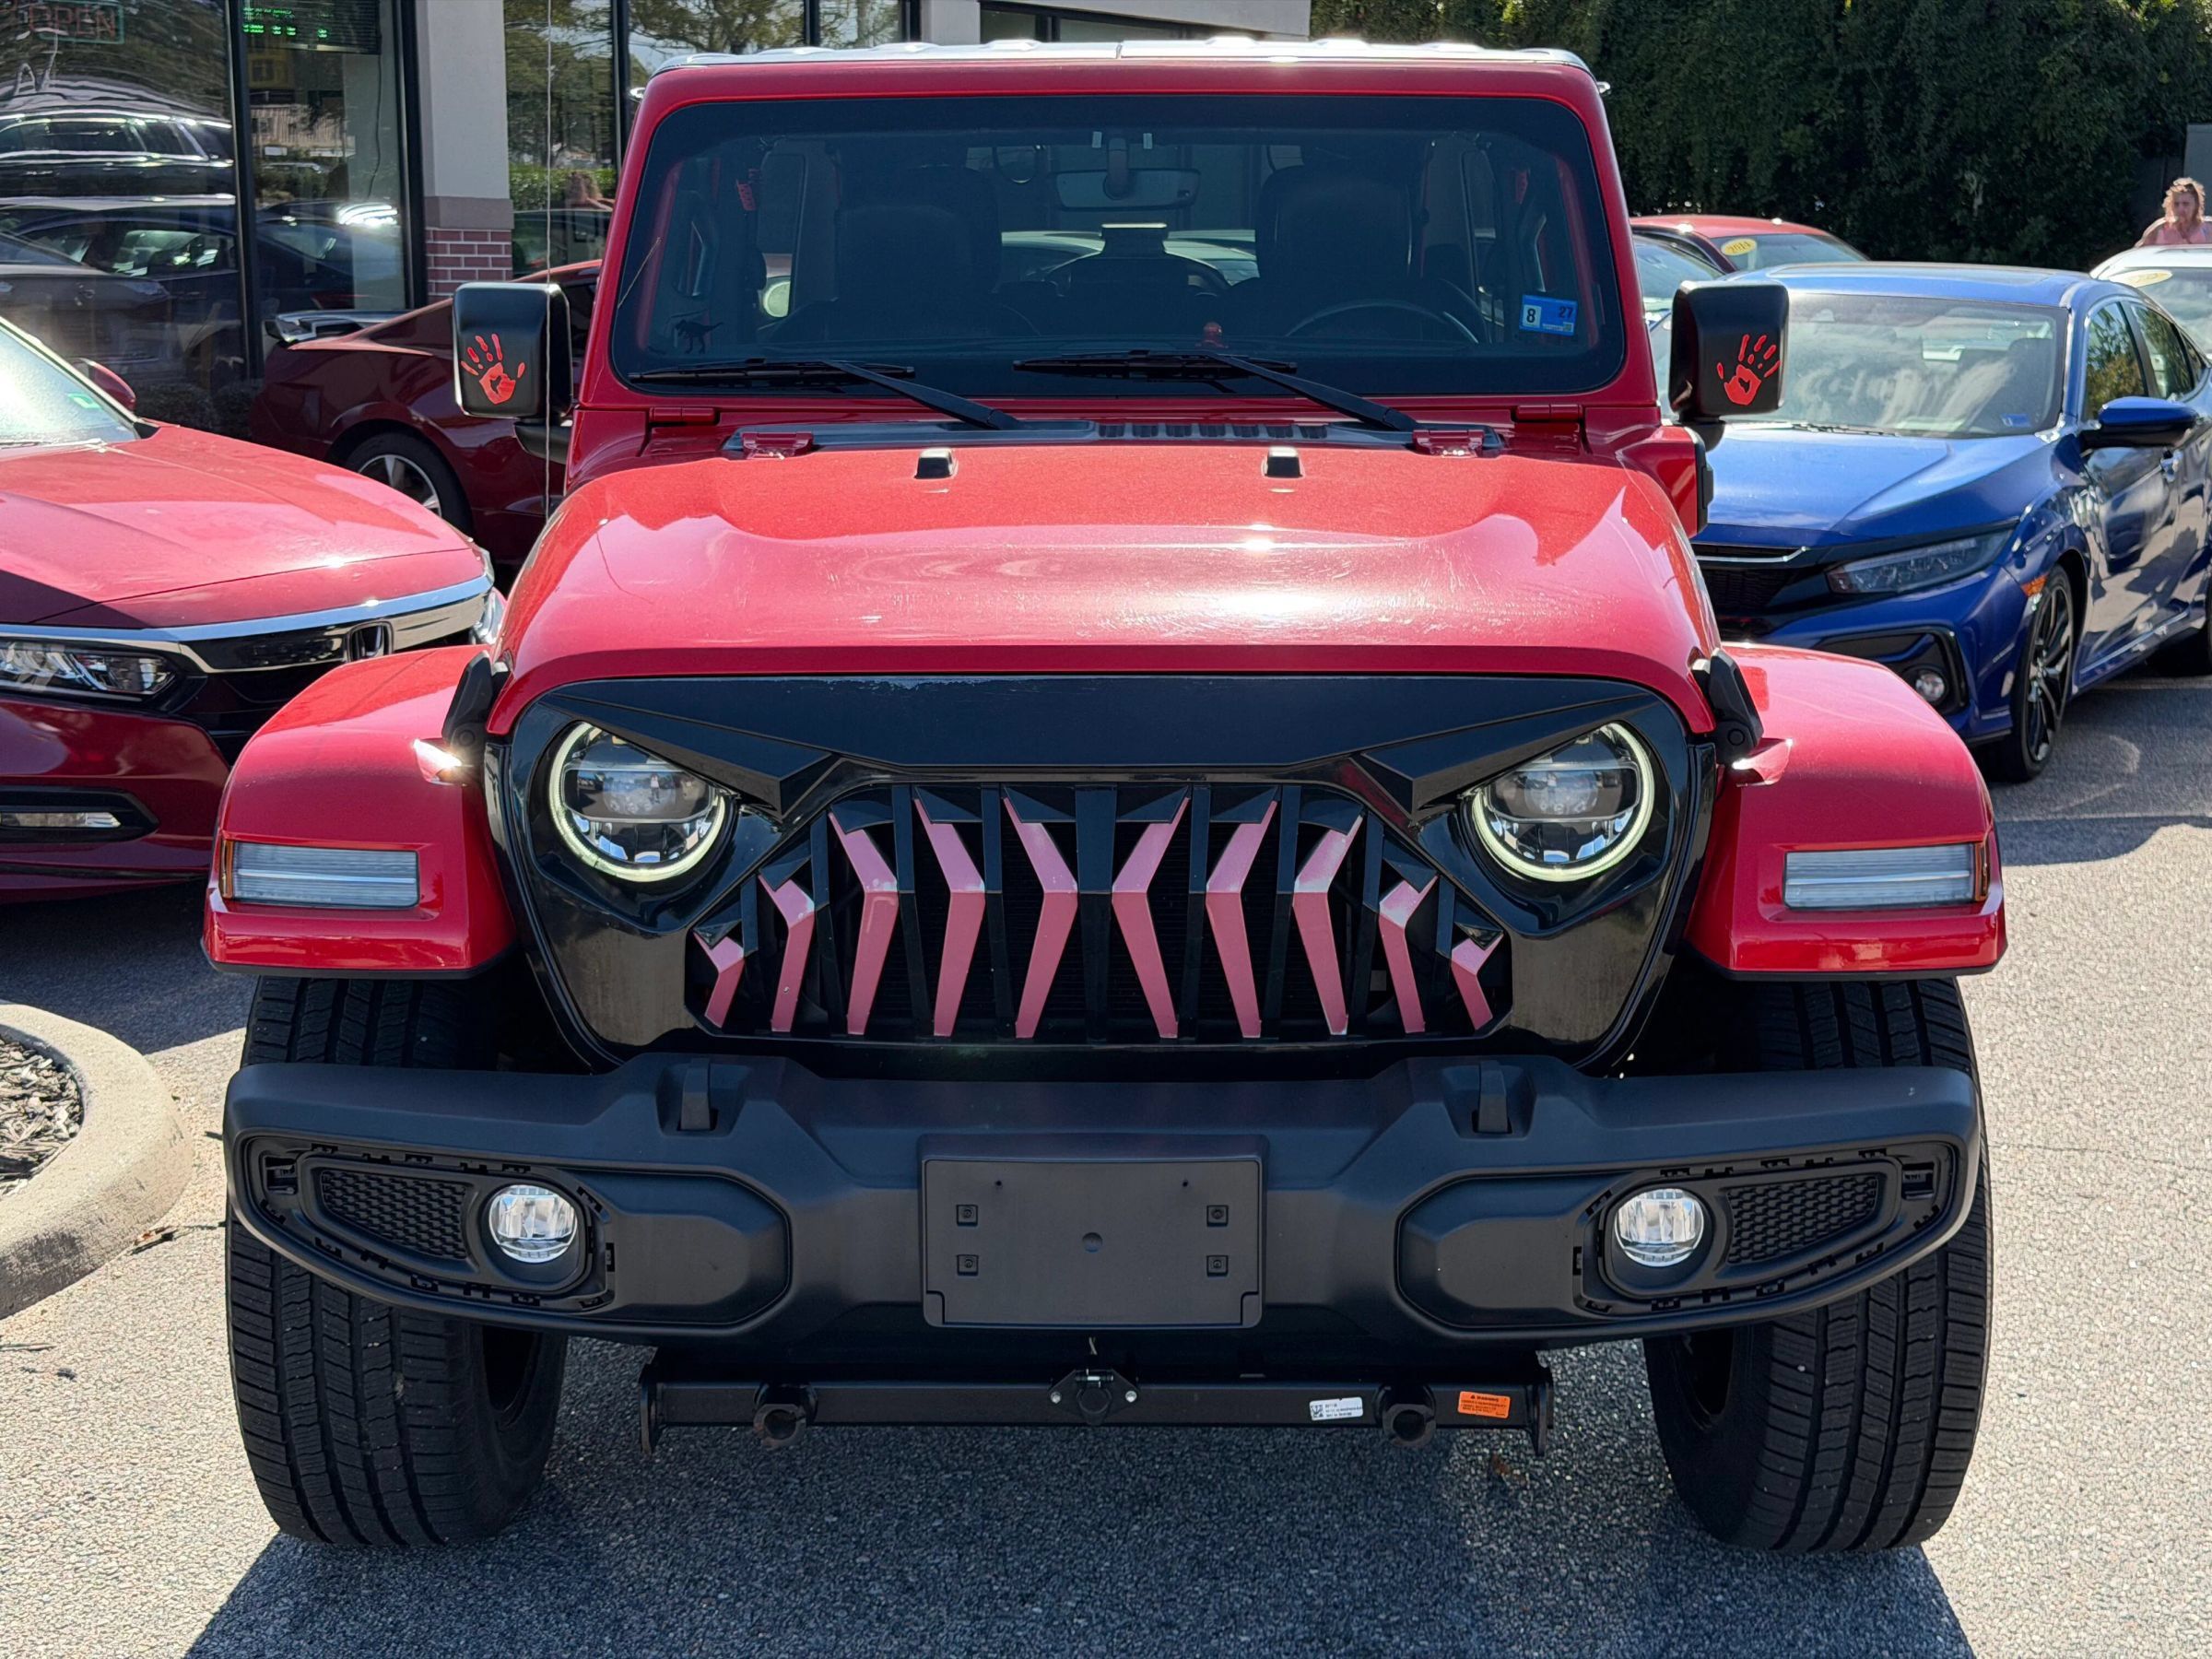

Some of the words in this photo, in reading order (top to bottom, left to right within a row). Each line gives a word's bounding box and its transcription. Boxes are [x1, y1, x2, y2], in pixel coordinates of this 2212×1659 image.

[29, 4, 116, 40] OPEN
[1526, 308, 1536, 324] 8
[1559, 305, 1574, 319] 27
